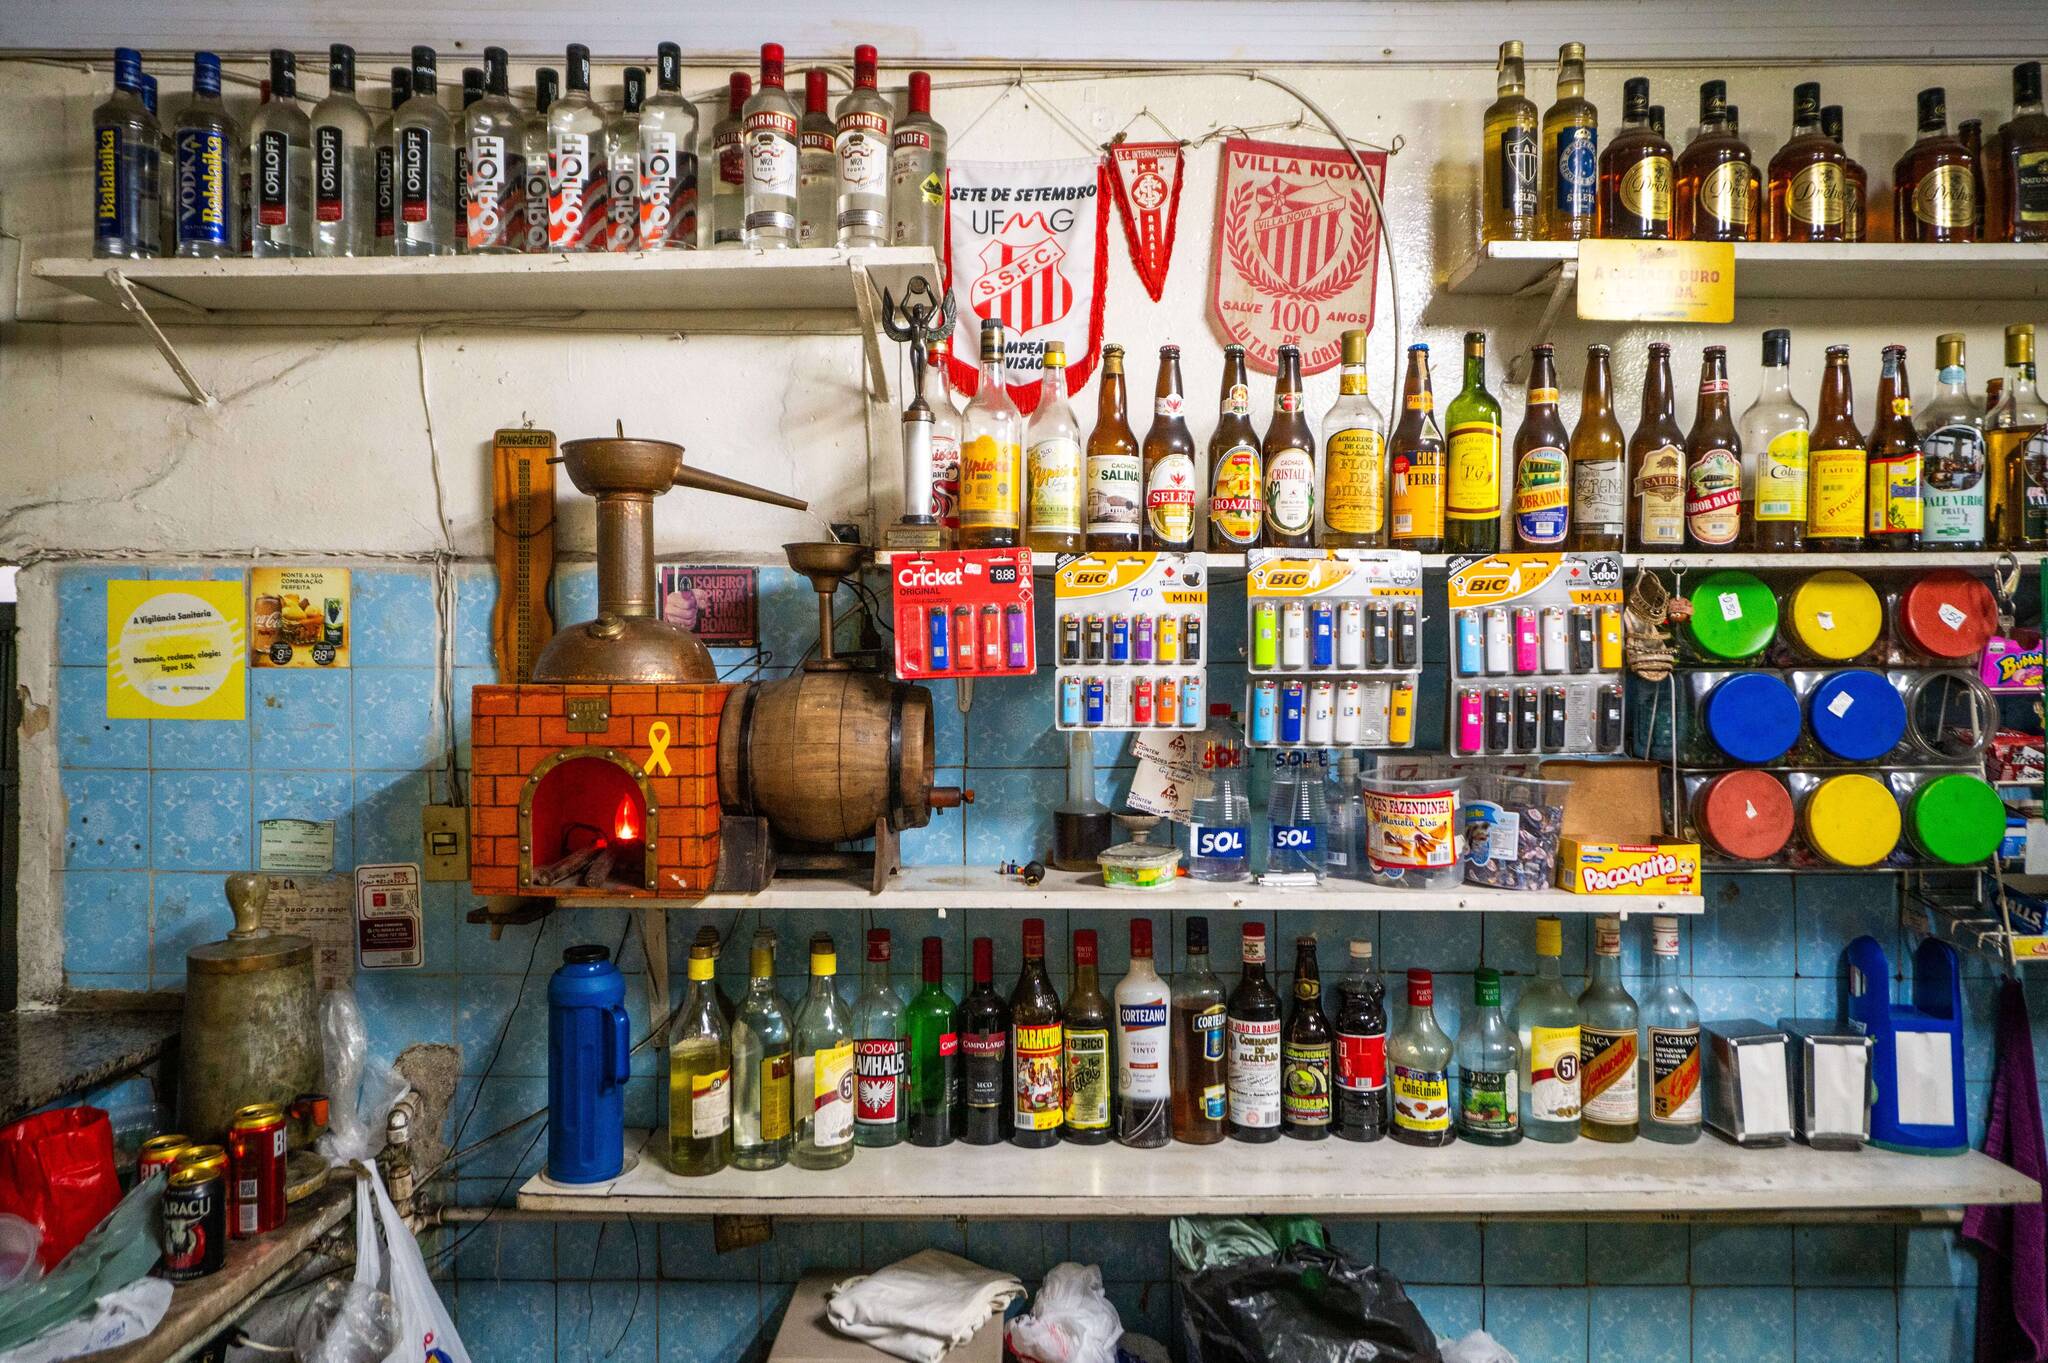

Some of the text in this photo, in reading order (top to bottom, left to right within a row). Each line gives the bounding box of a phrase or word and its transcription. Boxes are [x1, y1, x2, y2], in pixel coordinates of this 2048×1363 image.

[1234, 154, 1301, 175] VILLA
[100, 130, 115, 219] Balalaika
[181, 134, 202, 221] VODKA
[202, 136, 223, 224] Balalaika
[951, 184, 1097, 202] SETE DE SETEMBRO
[972, 208, 1075, 236] UFMG
[1257, 215, 1286, 230] VILLA
[1286, 209, 1312, 223] NOVA
[1148, 214, 1156, 269] BRASIL
[1222, 299, 1368, 335] SALVE 100 ANOS
[1231, 320, 1279, 363] LUTAS
[1283, 334, 1302, 345] DE
[1339, 458, 1378, 471] FLOR
[1349, 472, 1370, 484] DE
[693, 576, 745, 589] ISQUEIRO
[898, 565, 963, 587] Cricket
[1592, 572, 1617, 581] 3000
[705, 589, 745, 602] PIRATA
[900, 588, 941, 596] ORIGINAL
[1172, 593, 1203, 602] MINI
[1581, 592, 1617, 602] MAXI
[140, 613, 176, 625] Vigilância
[178, 610, 212, 620] Sanitária
[133, 655, 165, 665] Denuncie,
[167, 653, 196, 662] reclame,
[162, 664, 179, 673] ligue
[1389, 800, 1450, 815] FAZENDINHA
[1380, 815, 1414, 827] Mariola
[1201, 832, 1243, 853] SOL
[1277, 829, 1311, 847] SOL
[1583, 855, 1676, 892] Paçoquita
[1122, 1009, 1165, 1023] CORTEZANO
[1252, 1024, 1261, 1033] DA
[963, 1039, 985, 1049] CAMPO
[1017, 1025, 1061, 1049] PARATUD
[1082, 1038, 1103, 1049] RICO
[1655, 1035, 1698, 1047] CACHAÇA
[859, 1043, 896, 1054] VODKA
[1562, 1058, 1577, 1078] 51
